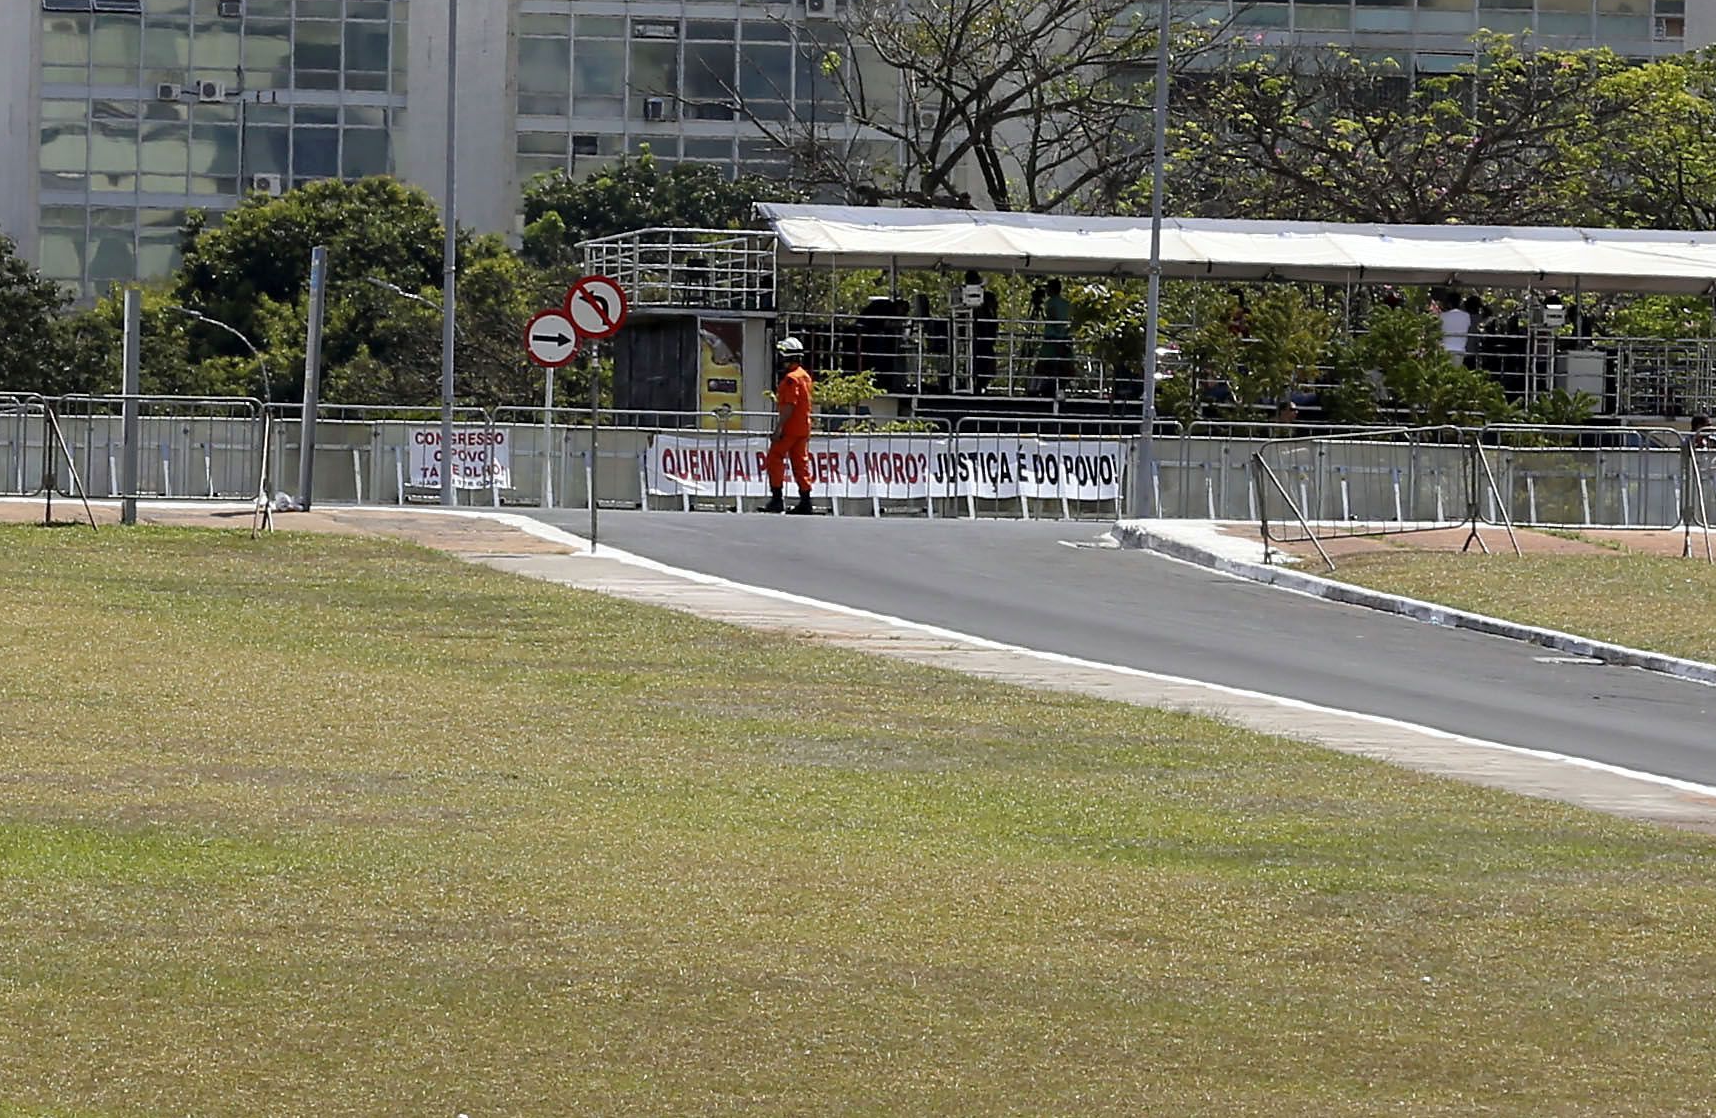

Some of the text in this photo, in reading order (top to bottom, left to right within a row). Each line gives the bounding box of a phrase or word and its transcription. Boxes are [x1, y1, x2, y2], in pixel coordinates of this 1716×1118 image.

[662, 444, 1120, 493] QUEM VAI PEDER O MORO? JUSTIÇA É DO POVO!
